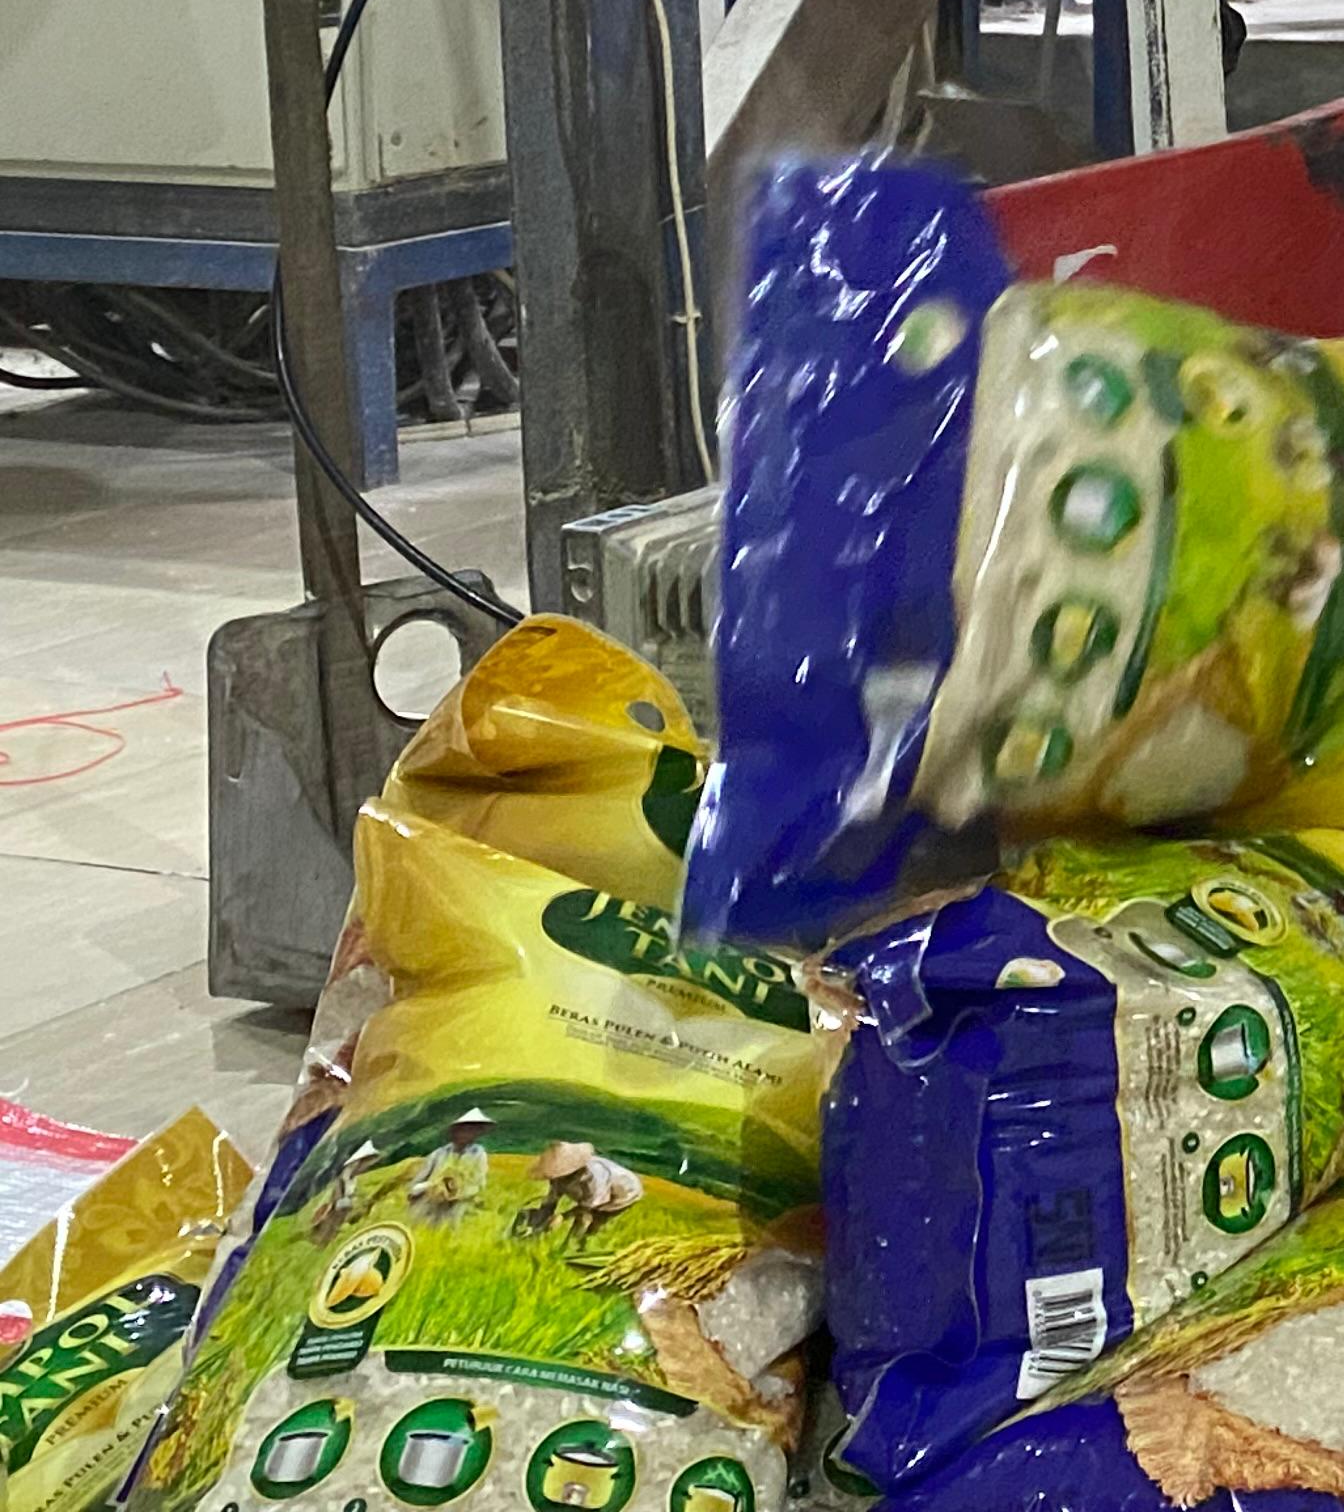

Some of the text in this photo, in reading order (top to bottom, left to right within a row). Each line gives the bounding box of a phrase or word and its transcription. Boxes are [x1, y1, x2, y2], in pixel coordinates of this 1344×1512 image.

[624, 926, 771, 1004] TANI
[549, 1004, 599, 1026] BERAS
[604, 1019, 657, 1042] PULEN
[647, 978, 726, 1014] PREMIUM
[47, 1378, 128, 1445] PREMIUM
[63, 1428, 130, 1487] PULEN &
